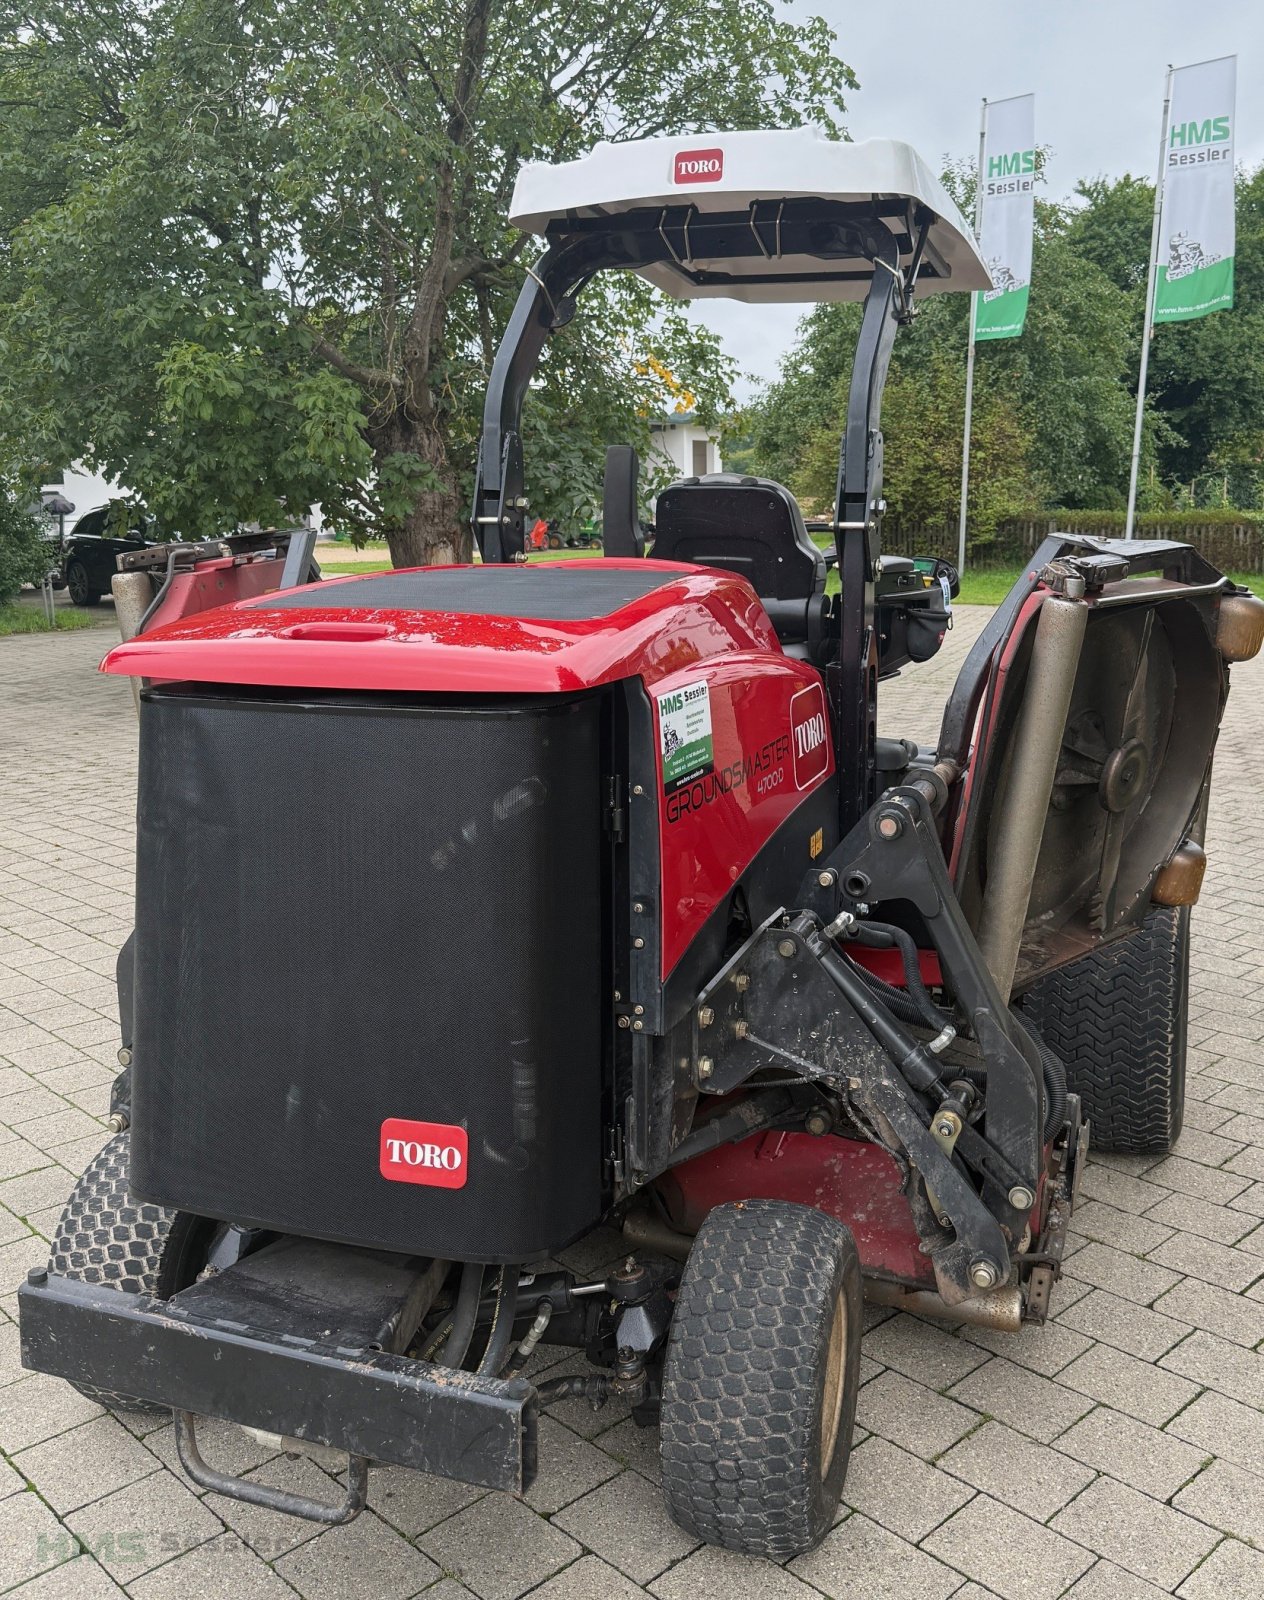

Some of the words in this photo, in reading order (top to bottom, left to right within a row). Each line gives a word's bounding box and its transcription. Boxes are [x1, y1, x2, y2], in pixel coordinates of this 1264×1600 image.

[1169, 115, 1230, 148] HMS
[987, 149, 1034, 178] HMS
[1168, 147, 1231, 167] Sessler
[987, 179, 1034, 196] Sessler
[659, 692, 684, 717] HMS
[683, 685, 708, 703] Sessler
[665, 734, 790, 824] GROUNDSMASTER
[386, 1138, 462, 1171] TORO
